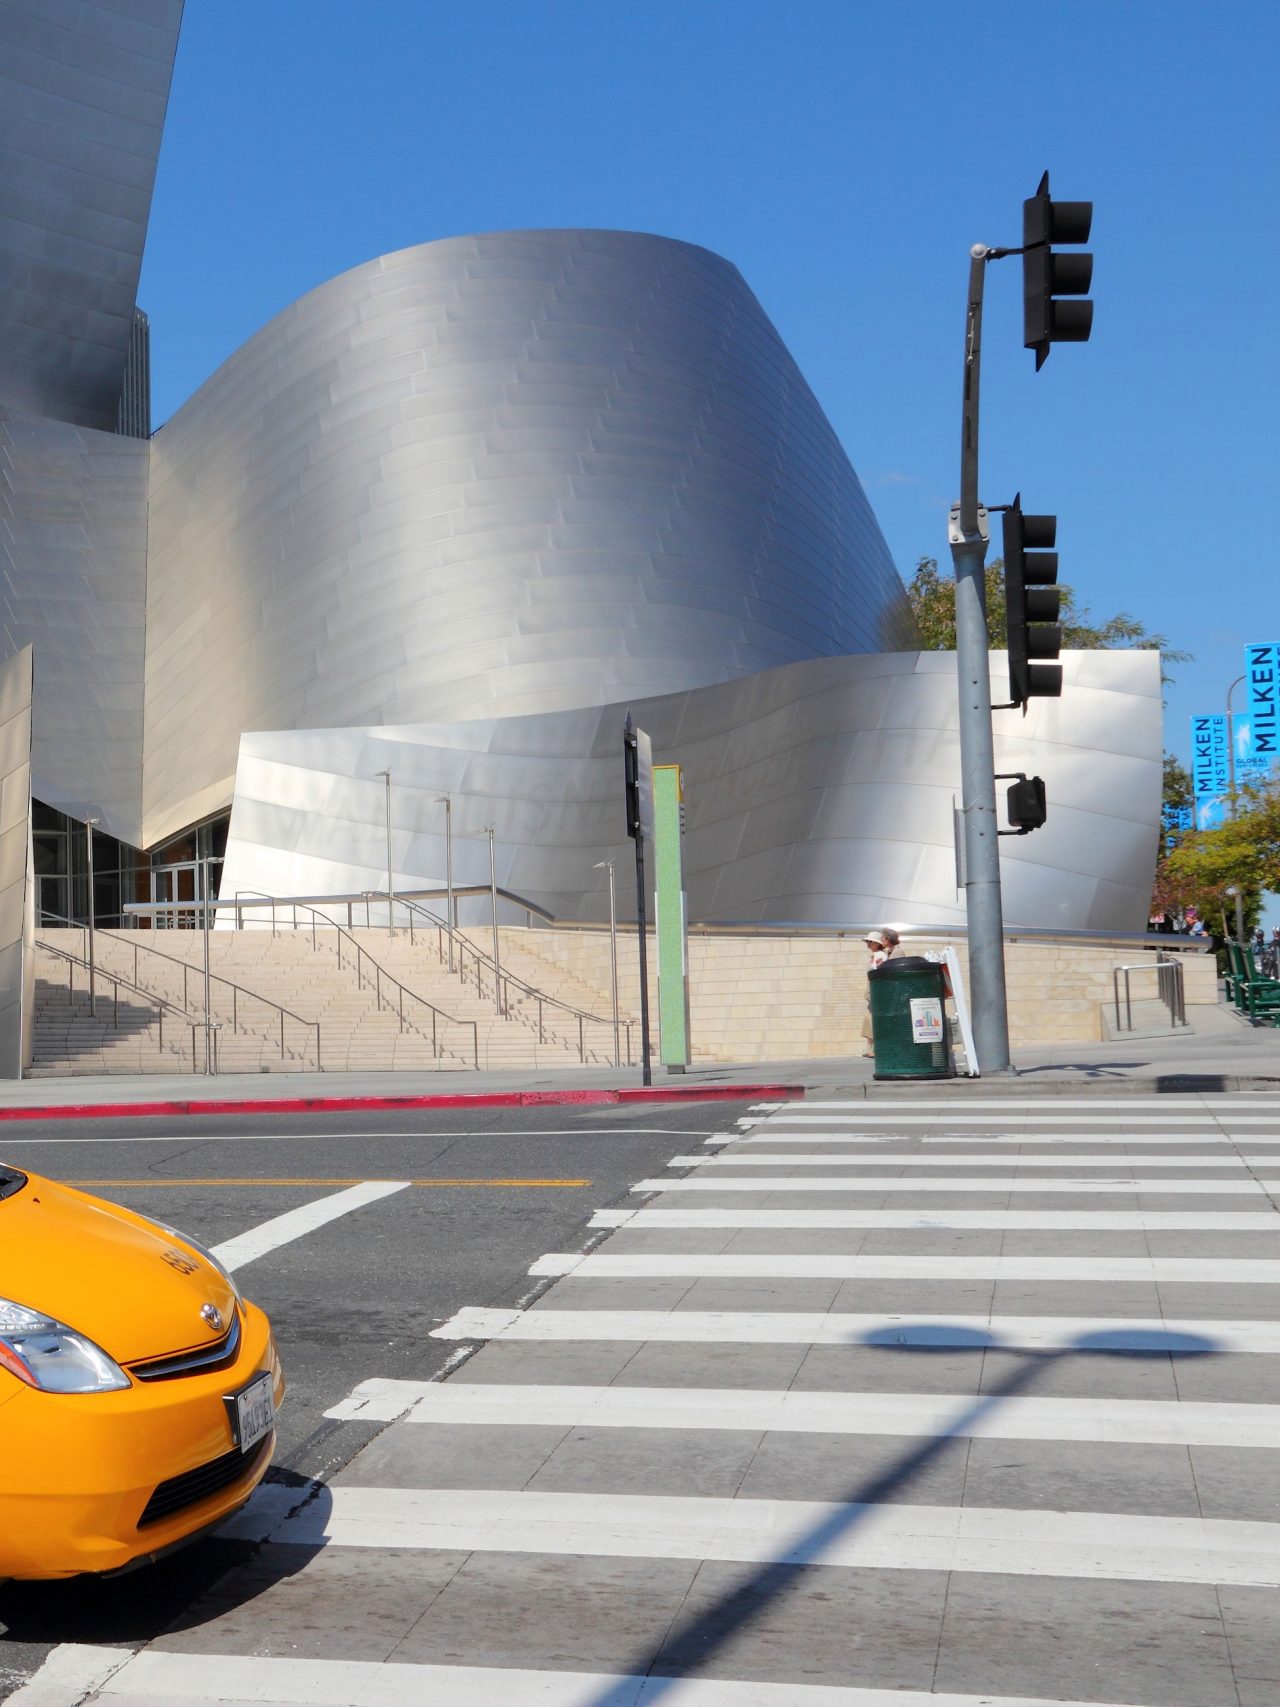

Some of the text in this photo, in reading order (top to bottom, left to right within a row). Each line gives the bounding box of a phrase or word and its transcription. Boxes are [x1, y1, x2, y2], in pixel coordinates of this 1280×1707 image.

[1251, 647, 1277, 752] MILKEN
[1195, 718, 1213, 792] MILKEN
[1213, 717, 1226, 791] INSTITUTE
